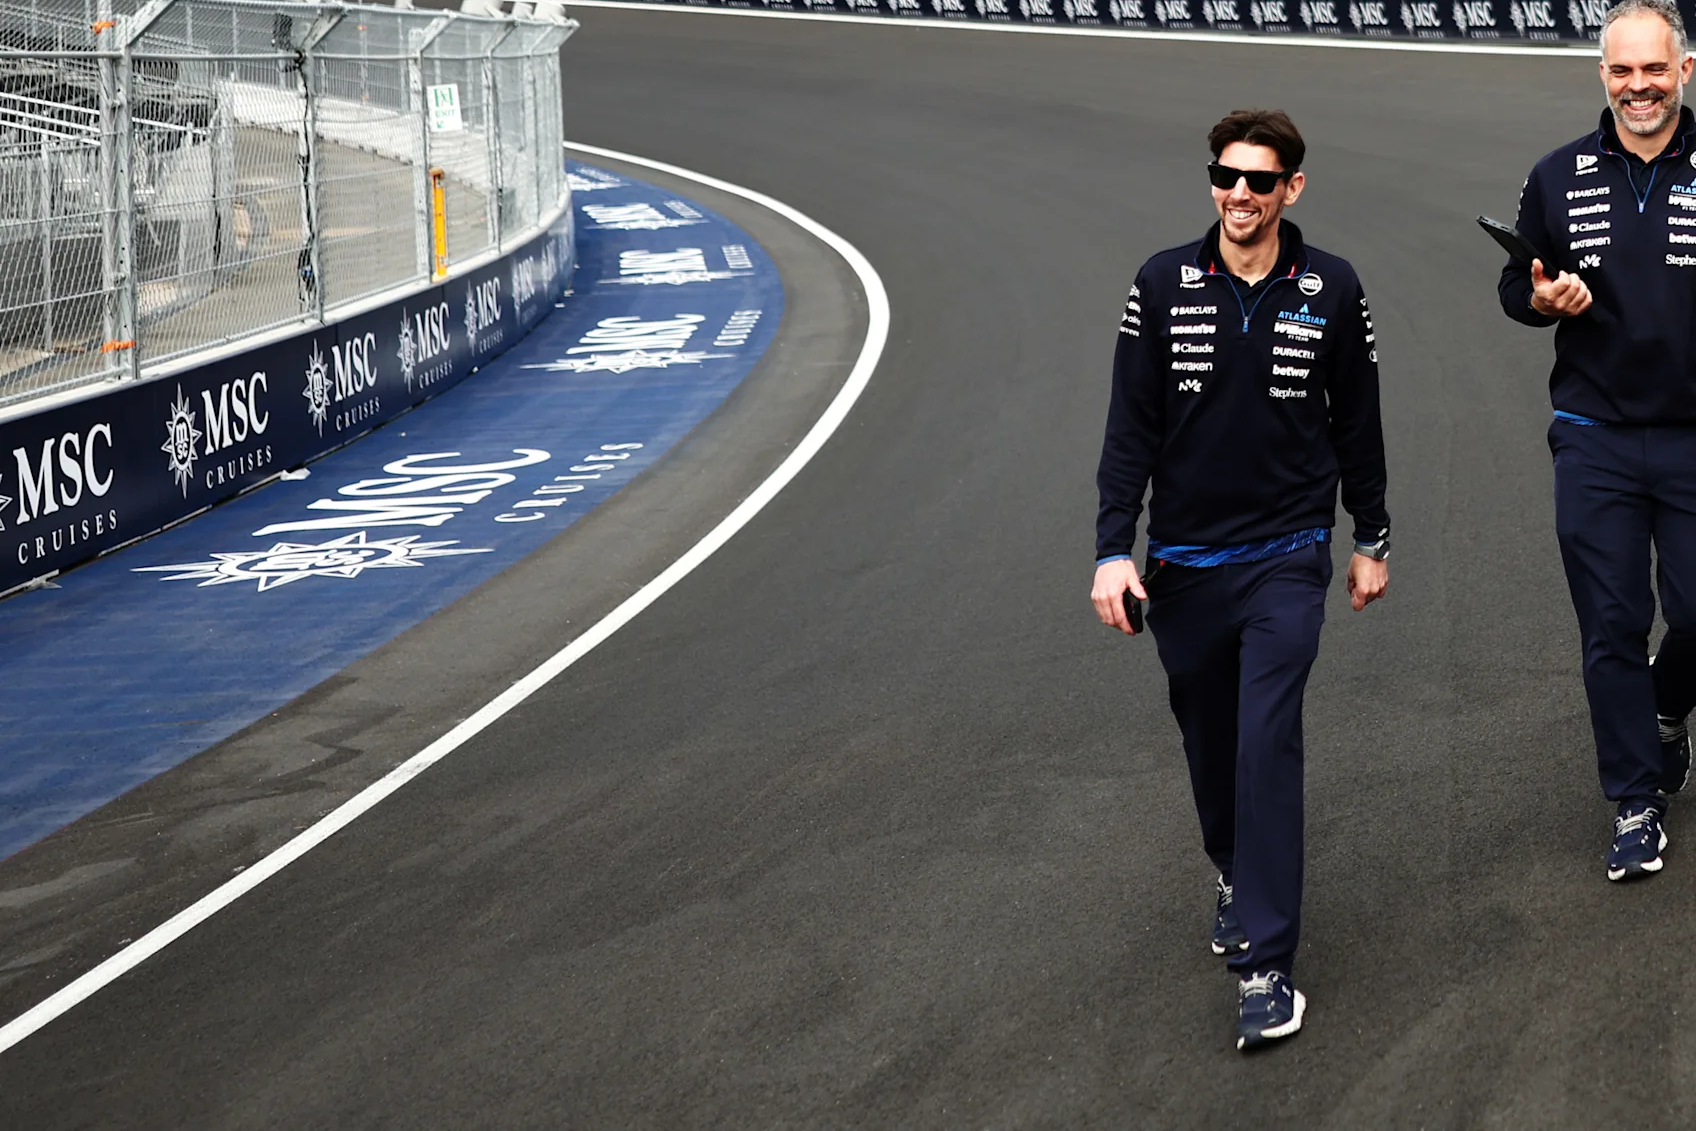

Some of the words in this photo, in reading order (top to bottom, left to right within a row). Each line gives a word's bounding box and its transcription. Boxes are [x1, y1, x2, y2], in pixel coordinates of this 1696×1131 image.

[1164, 0, 1191, 19] MSC
[1212, 0, 1240, 21] MSC
[1260, 1, 1289, 23] MSC
[1309, 1, 1338, 24] MSC
[1358, 1, 1388, 25] MSC
[1410, 3, 1441, 27] MSC
[1463, 1, 1496, 27] MSC
[1521, 1, 1555, 28] MSC
[1574, 186, 1610, 198] BARCLAYS
[1579, 220, 1610, 232] Claude
[1576, 236, 1611, 249] kraken
[476, 277, 501, 330] MSC
[1179, 305, 1217, 315] BARCLAYS
[1278, 311, 1327, 326] ATLASSIAN
[415, 301, 451, 363] MSC
[1274, 322, 1323, 339] Williams
[1180, 343, 1214, 353] Claude
[1272, 346, 1315, 360] DURACELL
[331, 333, 377, 402] MSC
[1179, 361, 1213, 371] kraken
[1272, 364, 1310, 379] betway
[1269, 386, 1307, 399] Stephens
[201, 371, 269, 456] MSC
[336, 397, 380, 431] CRUISES
[13, 423, 113, 525] MSC
[206, 445, 271, 489] CRUISES
[252, 448, 551, 537] MSC
[495, 443, 643, 522] CRUISES
[18, 509, 117, 564] CRUISES
